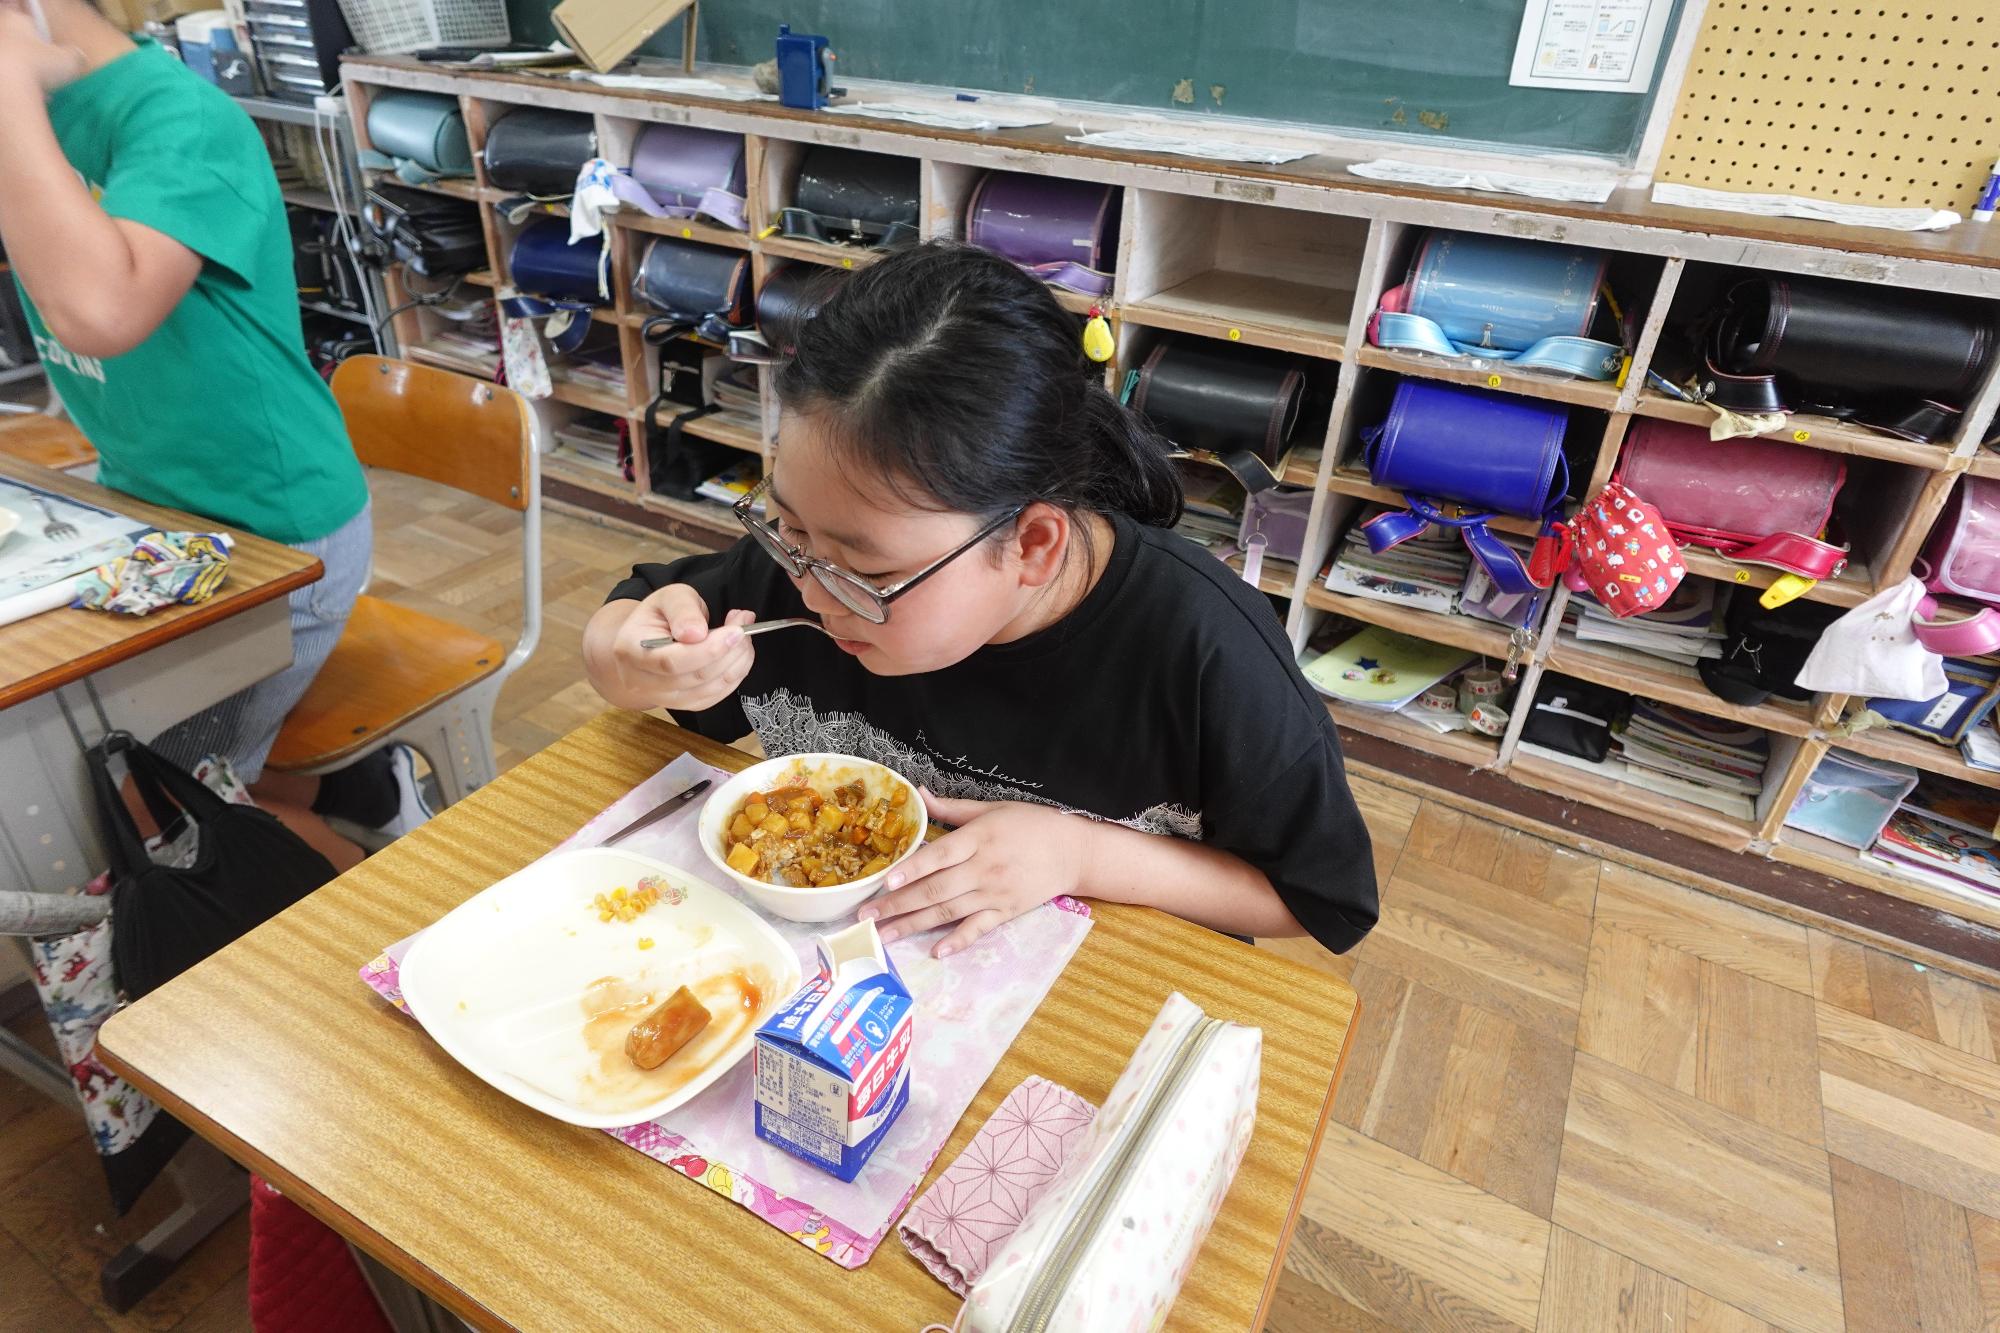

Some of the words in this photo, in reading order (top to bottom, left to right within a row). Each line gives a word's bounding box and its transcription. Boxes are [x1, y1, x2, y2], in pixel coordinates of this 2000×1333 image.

[1948, 834, 1969, 848] 6
[856, 1025, 912, 1113] 毎日牛乳
